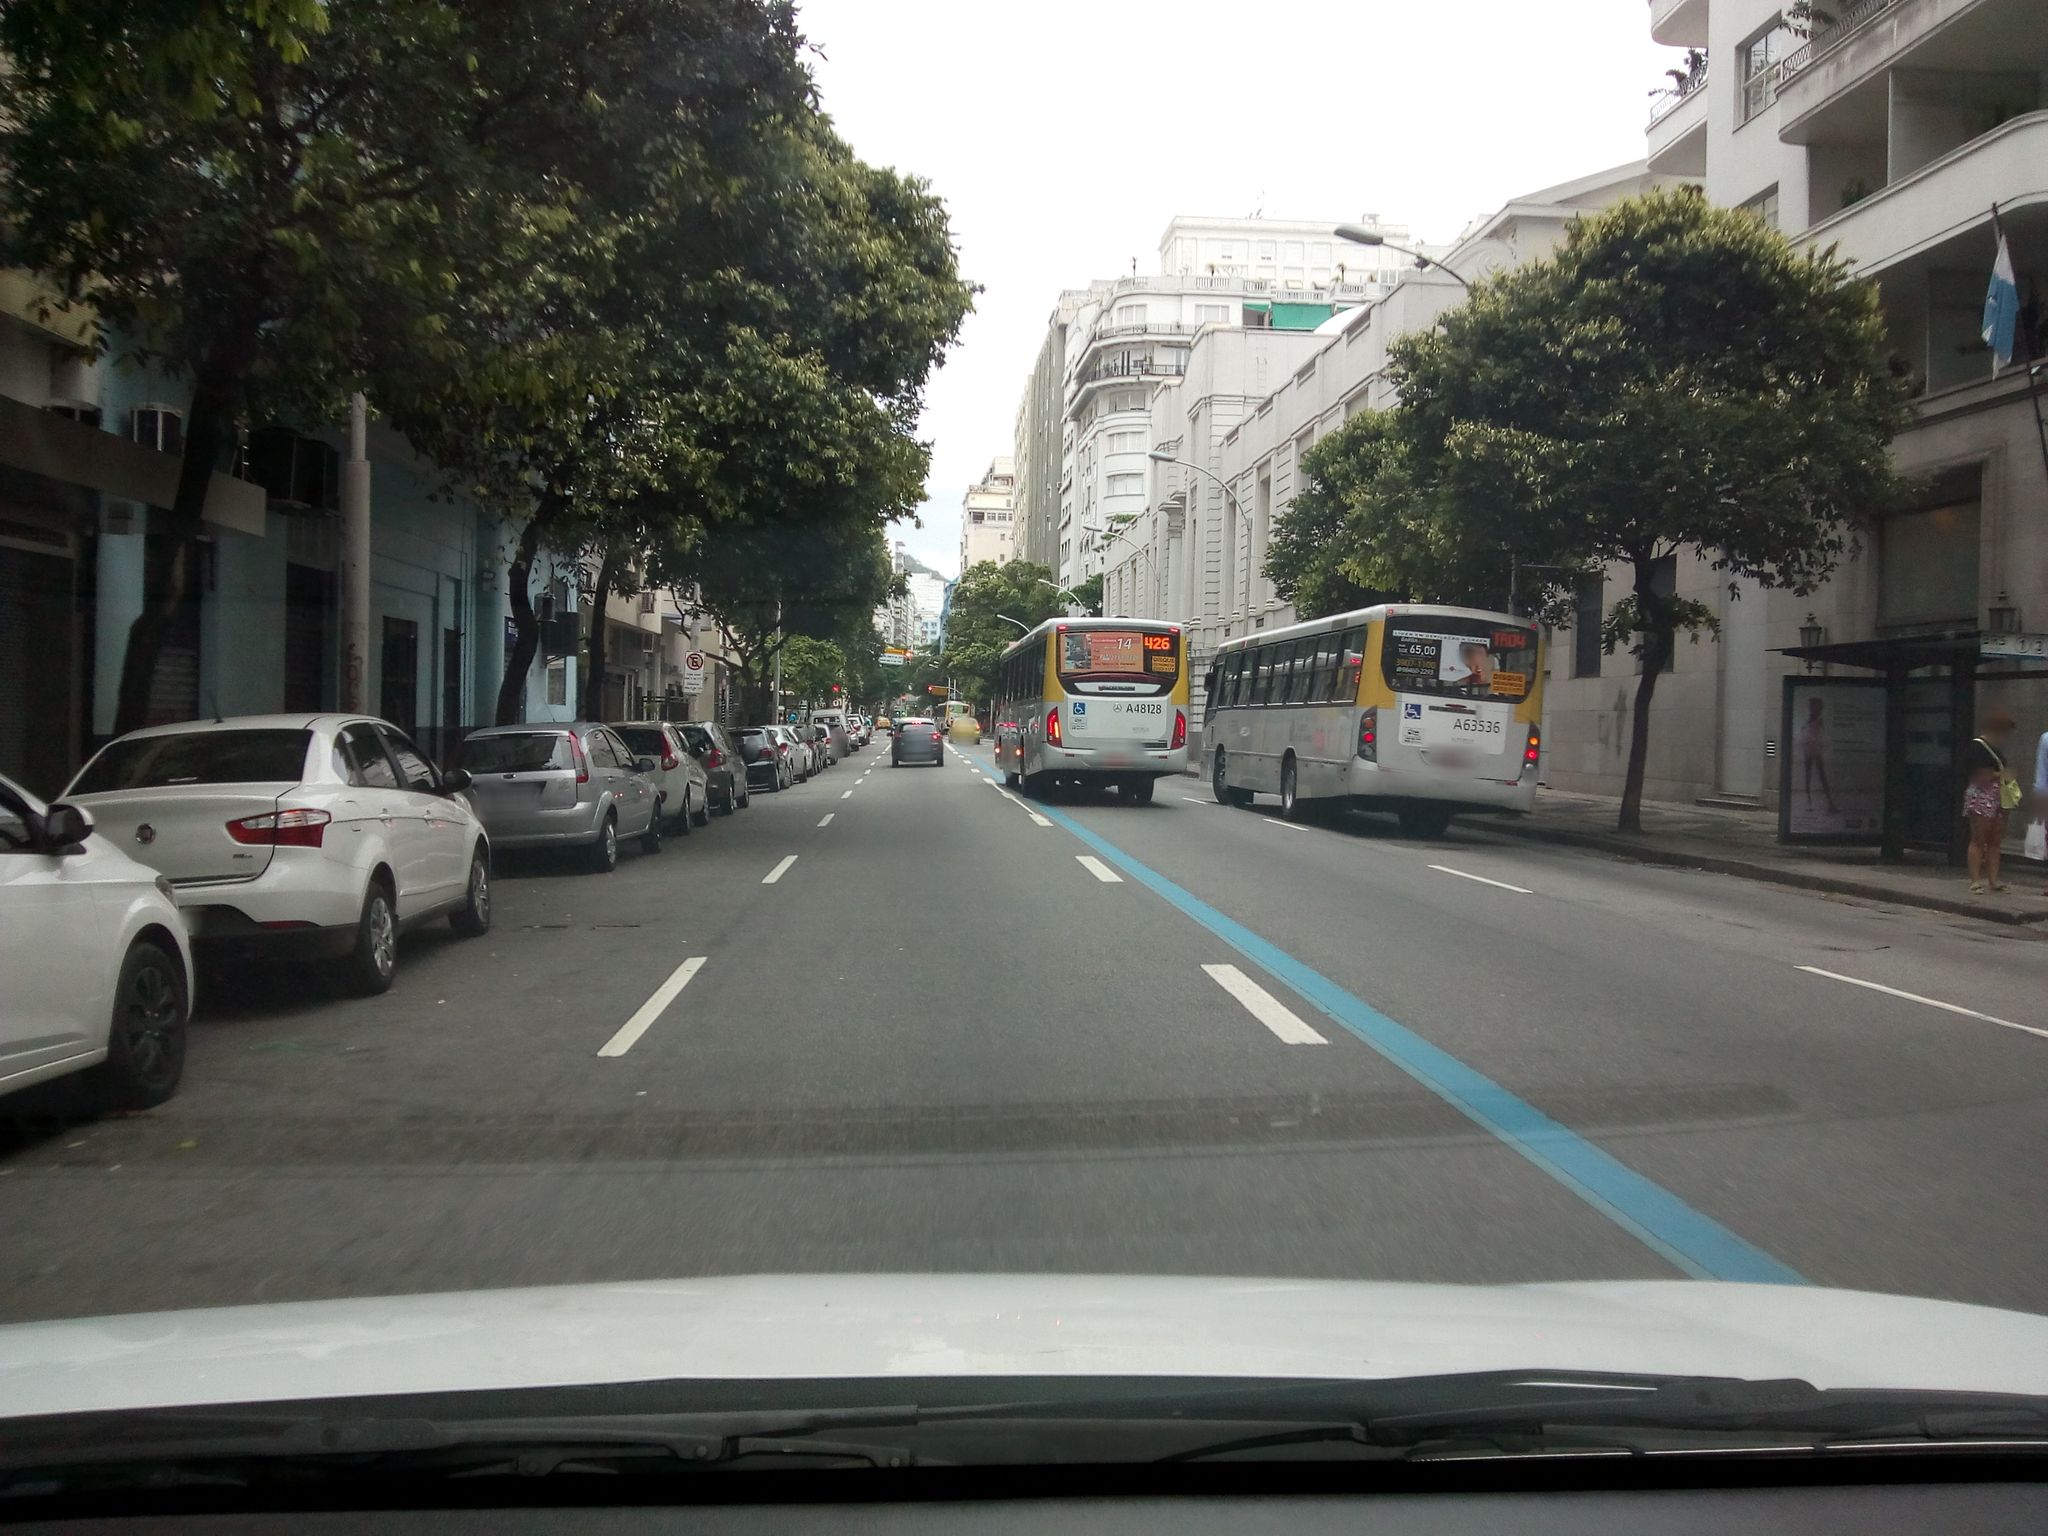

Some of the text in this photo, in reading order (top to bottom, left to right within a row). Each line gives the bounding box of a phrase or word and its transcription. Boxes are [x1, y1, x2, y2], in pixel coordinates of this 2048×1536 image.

[1117, 638, 1132, 650] 14
[1144, 636, 1170, 650] 426
[1126, 703, 1162, 715] A48128
[1453, 718, 1501, 734] A63536
